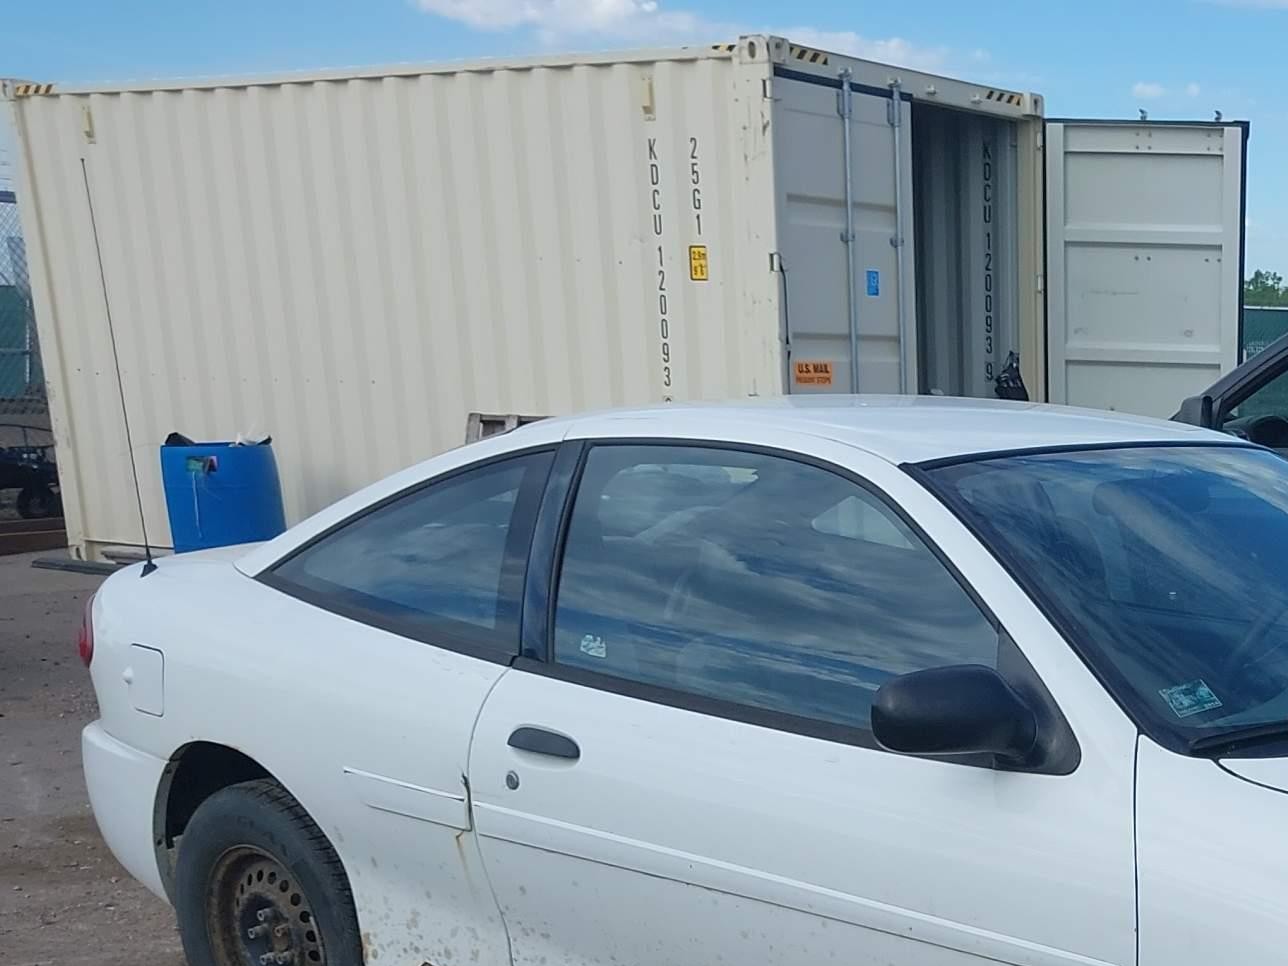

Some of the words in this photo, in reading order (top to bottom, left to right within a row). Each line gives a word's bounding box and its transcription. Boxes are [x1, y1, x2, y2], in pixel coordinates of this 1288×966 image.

[689, 136, 703, 236] 25G1
[983, 142, 993, 224] KDCU
[647, 138, 662, 237] KDCU
[656, 245, 672, 388] 120093
